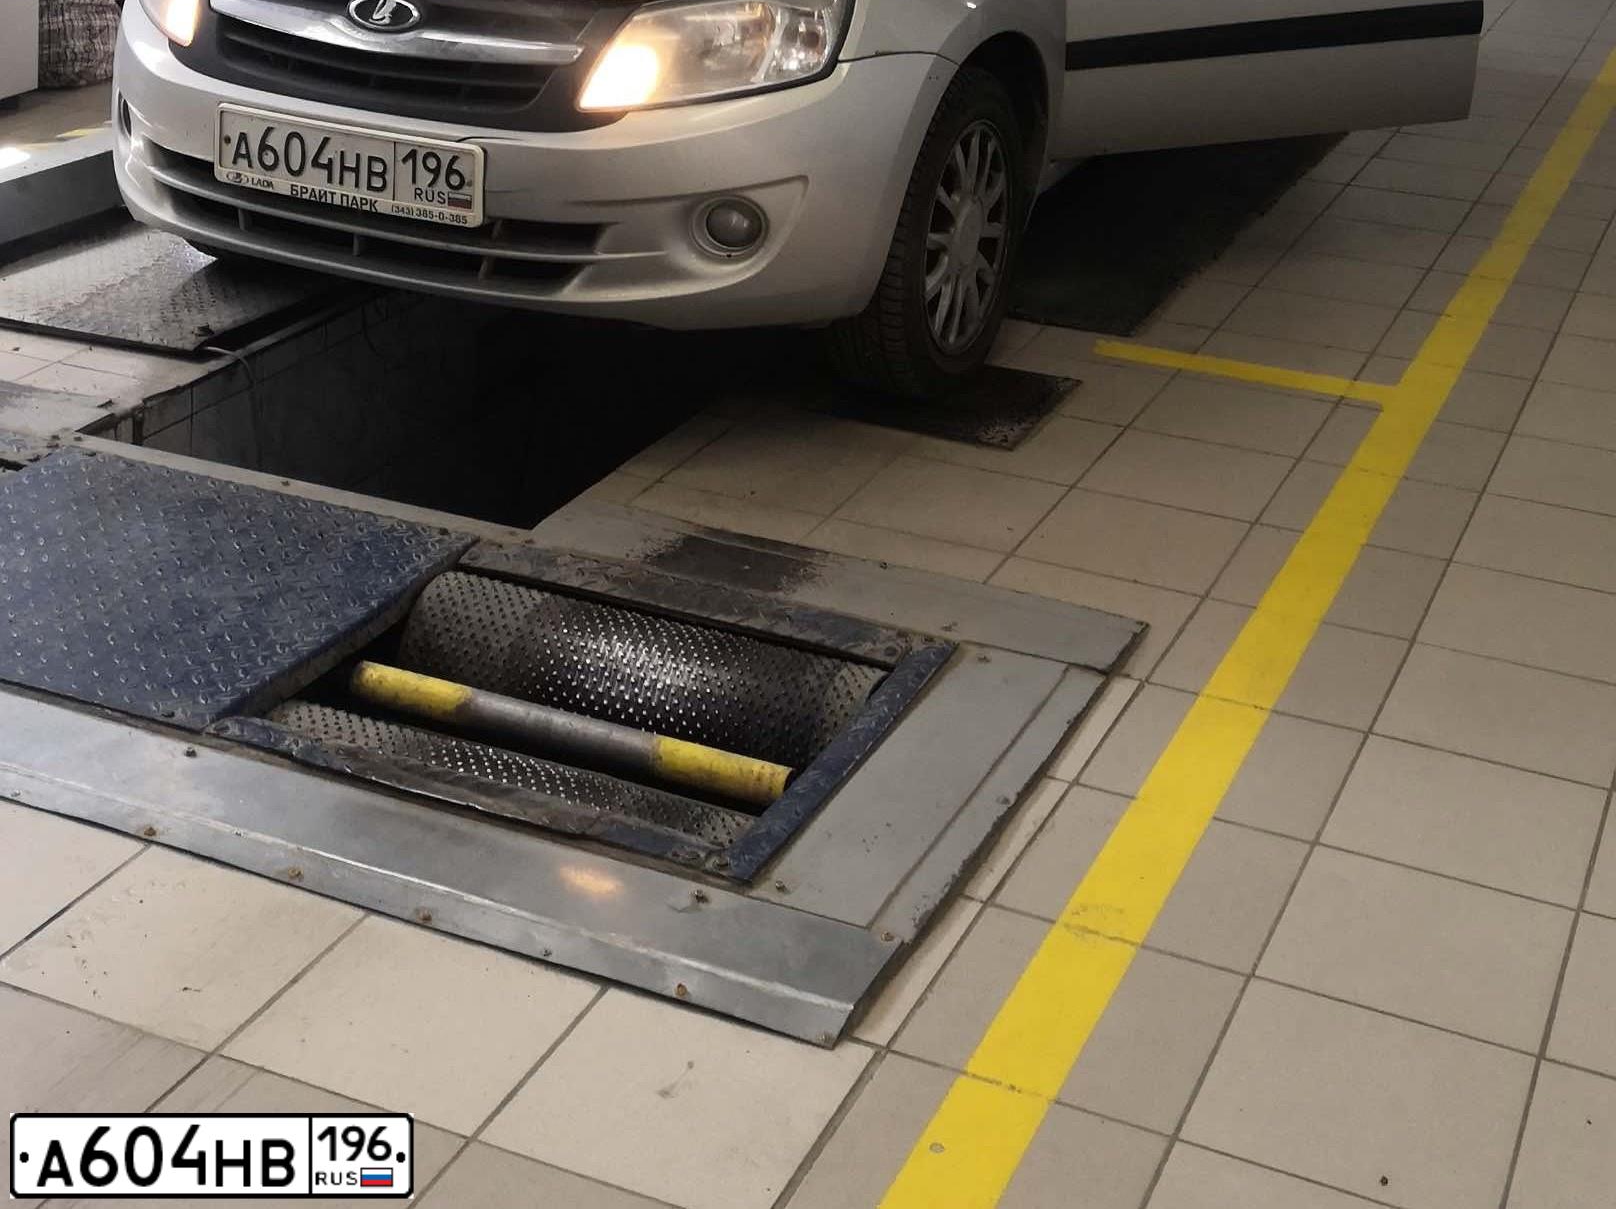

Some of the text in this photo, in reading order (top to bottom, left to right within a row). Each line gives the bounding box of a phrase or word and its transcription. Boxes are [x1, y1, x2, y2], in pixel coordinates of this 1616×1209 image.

[232, 126, 466, 192] А604НВ 196
[251, 177, 274, 190] LADA
[340, 193, 378, 213] ПАРК
[414, 187, 446, 205] RUS
[391, 204, 468, 225] (343) 385-0-385
